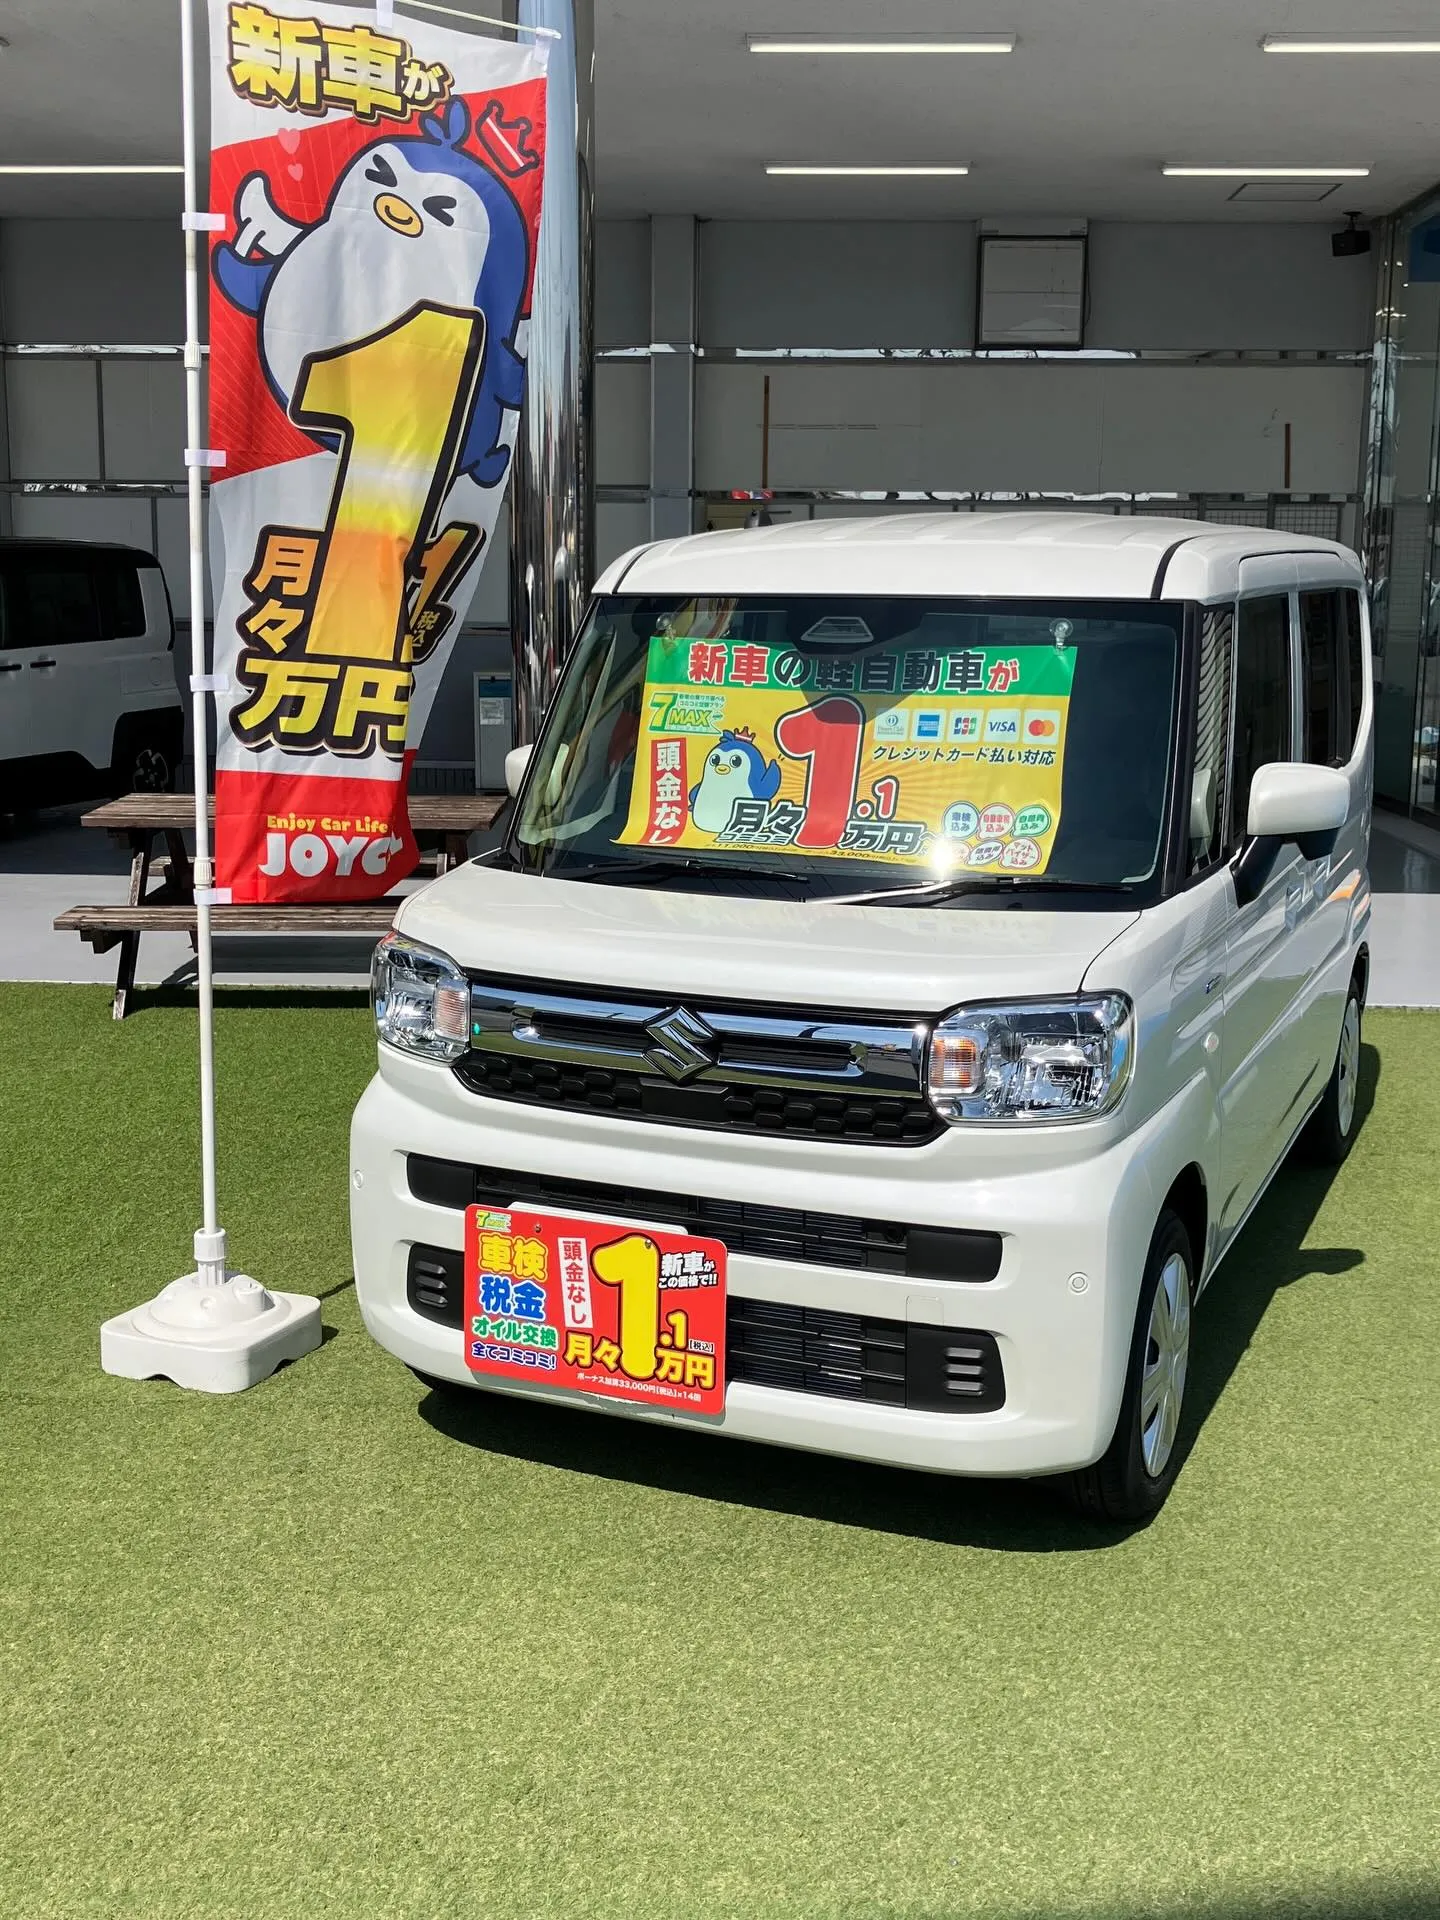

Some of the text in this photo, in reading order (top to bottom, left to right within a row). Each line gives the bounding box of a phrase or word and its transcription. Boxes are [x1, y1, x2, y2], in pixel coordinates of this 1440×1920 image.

[229, 5, 448, 116] 新車が
[252, 535, 319, 654] 月々
[688, 643, 1019, 692] 新車の軽自動車が
[954, 717, 977, 735] JCB
[988, 721, 1017, 733] VISA
[873, 746, 1057, 766] クレジットカード払い対応
[648, 741, 682, 844] 頭金なし
[266, 812, 389, 833] Enjoy Car Life
[951, 822, 970, 832] 込み
[985, 823, 1005, 833] 込み
[1021, 822, 1039, 831] 込み
[479, 1234, 547, 1280] 車検
[661, 1251, 715, 1277] 新車が
[563, 1240, 587, 1324] 頭金なし
[481, 1276, 545, 1319] 税金
[473, 1317, 557, 1347] オイル交換
[563, 1333, 622, 1372] 月々
[655, 1347, 716, 1388] 万円
